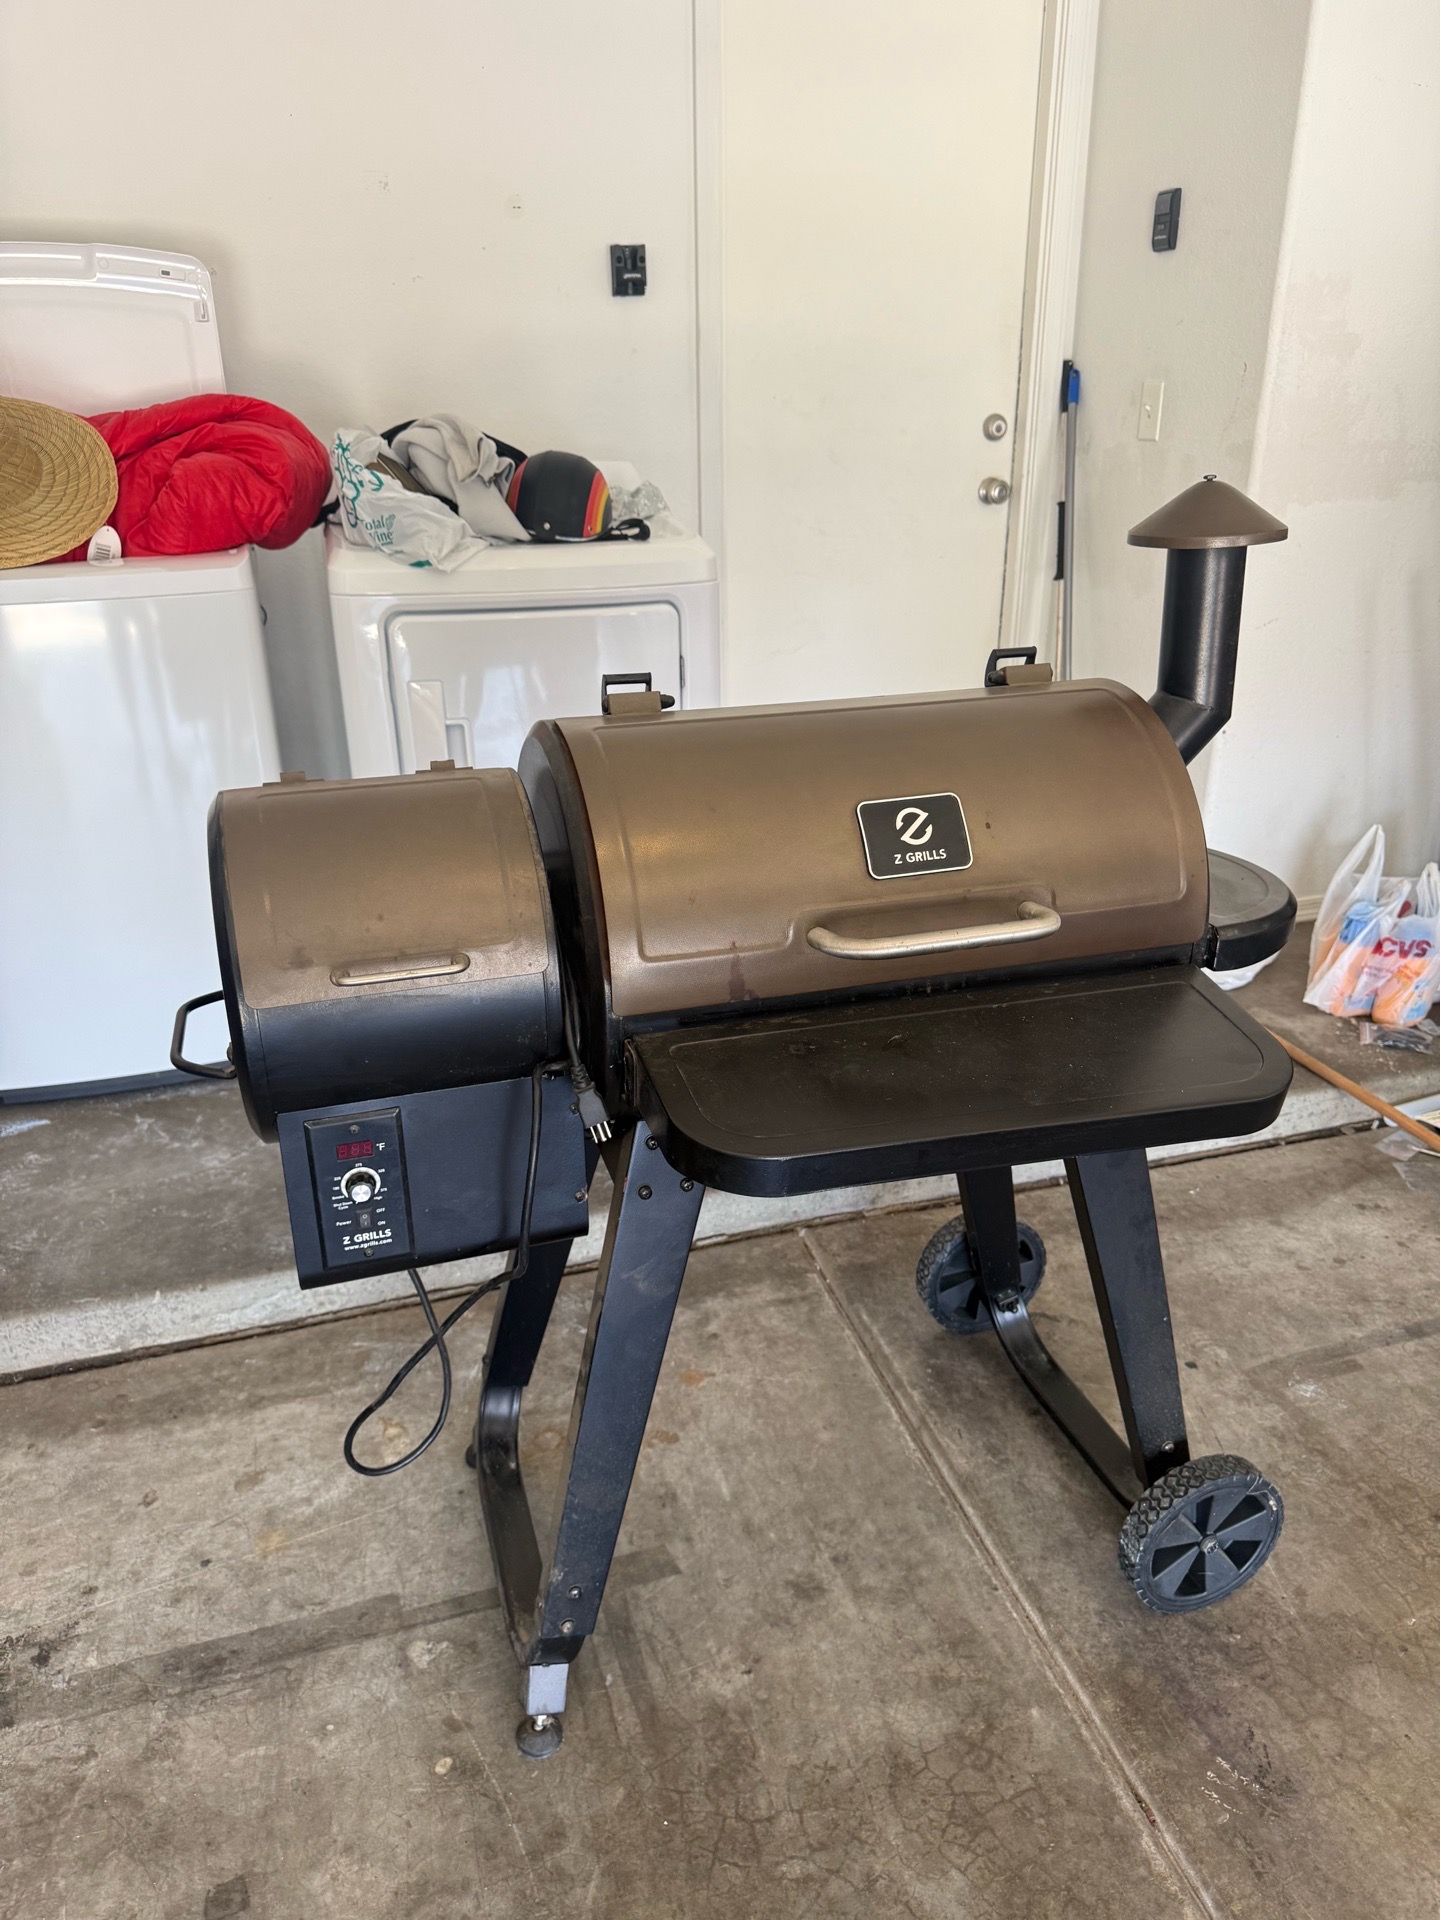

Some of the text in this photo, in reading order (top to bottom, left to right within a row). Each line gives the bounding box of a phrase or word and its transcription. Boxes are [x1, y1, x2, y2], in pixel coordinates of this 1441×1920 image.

[365, 515, 385, 530] otal
[894, 848, 947, 865] Z GRILLS
[1382, 937, 1432, 958] CVS
[342, 1228, 392, 1245] Z GRILLS
